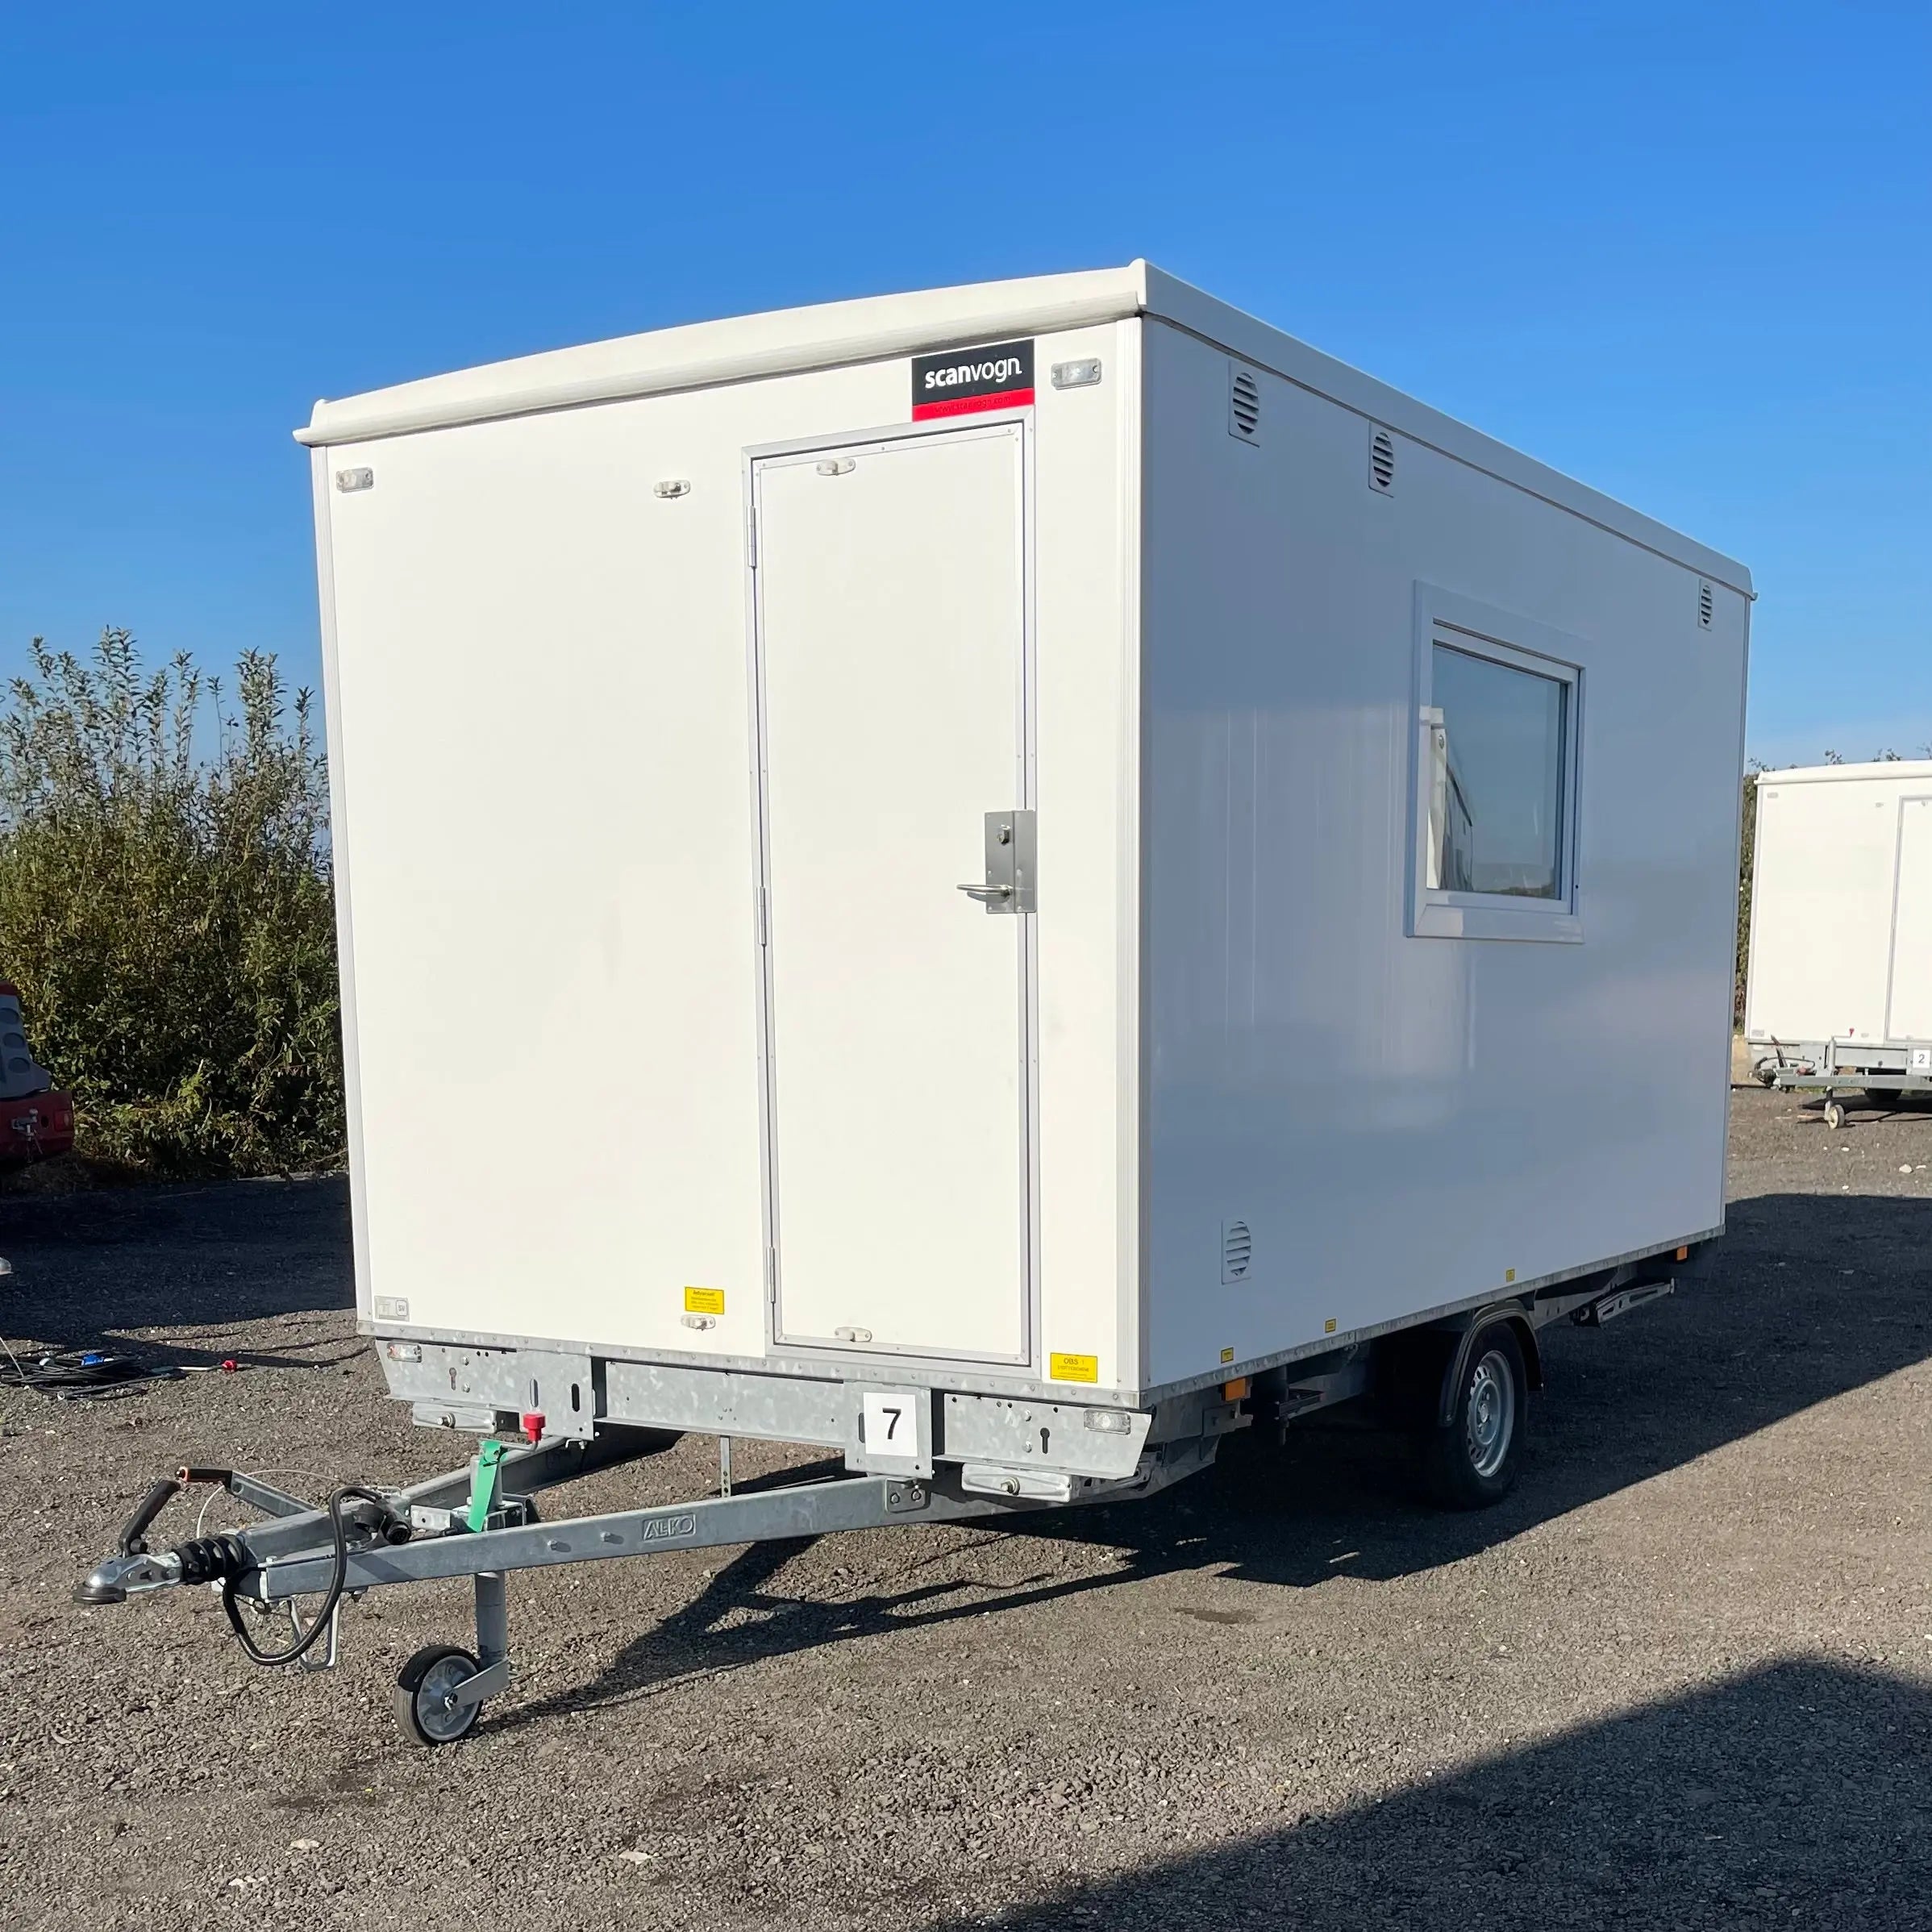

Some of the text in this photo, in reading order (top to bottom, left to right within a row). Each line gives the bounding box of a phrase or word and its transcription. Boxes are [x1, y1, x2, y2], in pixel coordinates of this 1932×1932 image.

[925, 356, 1022, 389] scanvogn
[1918, 1053, 1925, 1064] 2
[882, 1407, 901, 1440] 7
